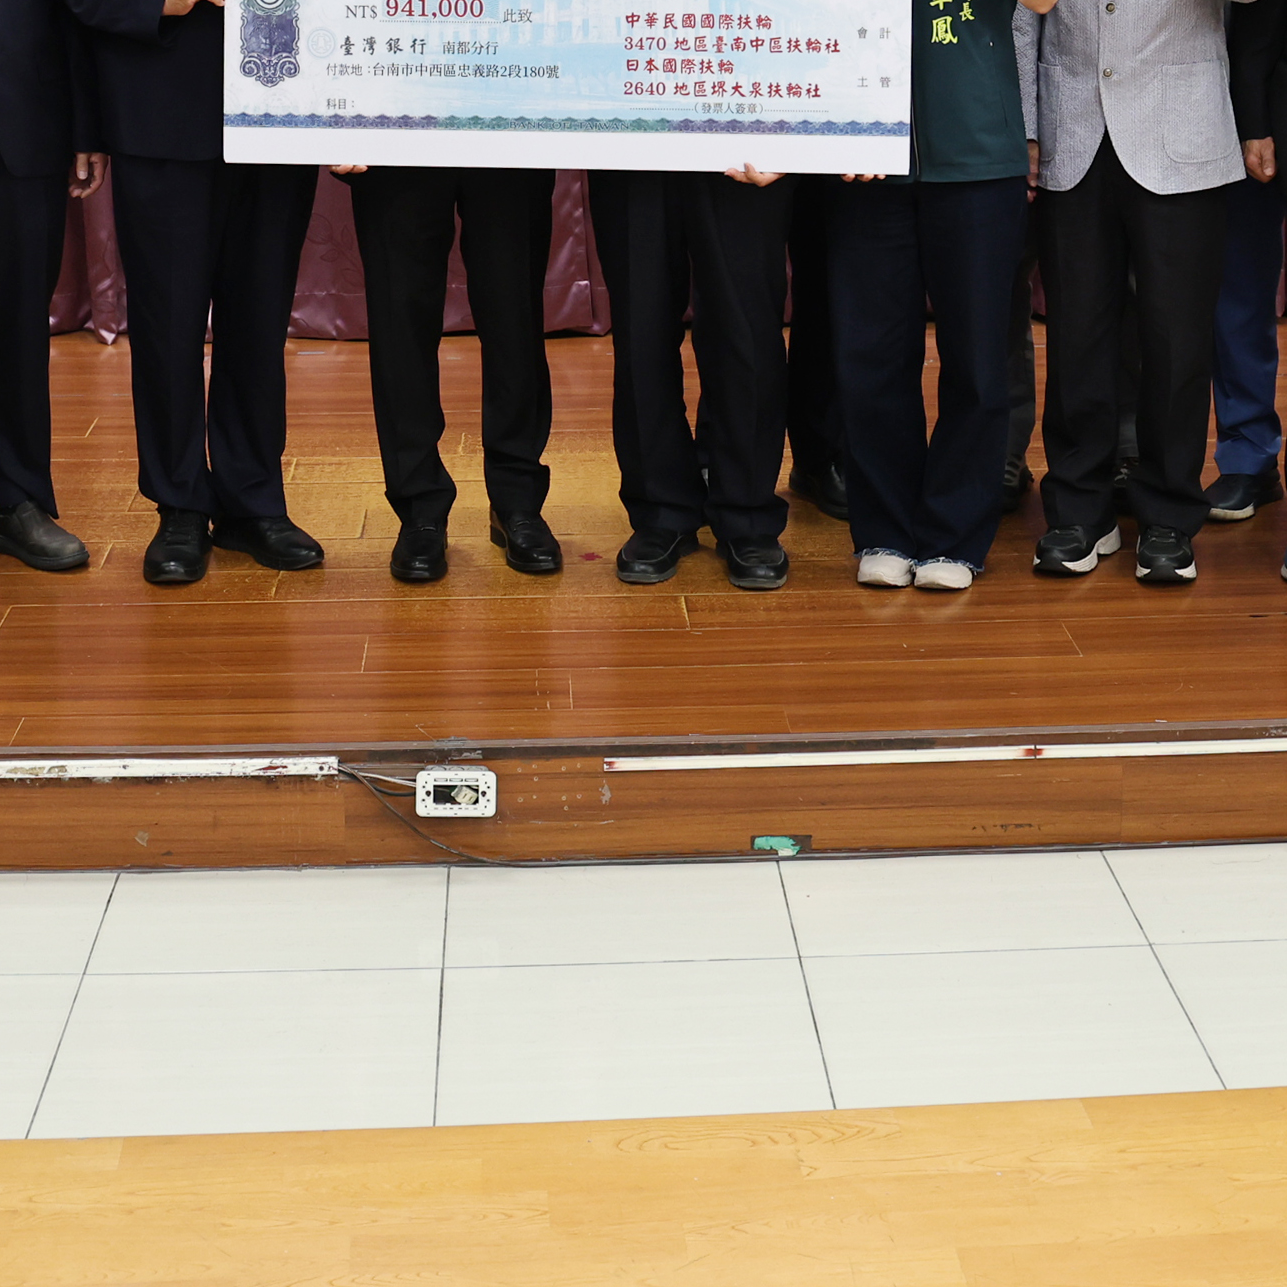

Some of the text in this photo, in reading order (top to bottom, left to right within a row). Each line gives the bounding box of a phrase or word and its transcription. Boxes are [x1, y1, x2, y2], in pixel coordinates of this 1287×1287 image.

[345, 4, 378, 21] NT$
[502, 8, 533, 24] 此致
[624, 12, 773, 31] 中華民國國際扶輪
[442, 41, 499, 56] 南都分行
[625, 57, 735, 76] 日本國際扶輪
